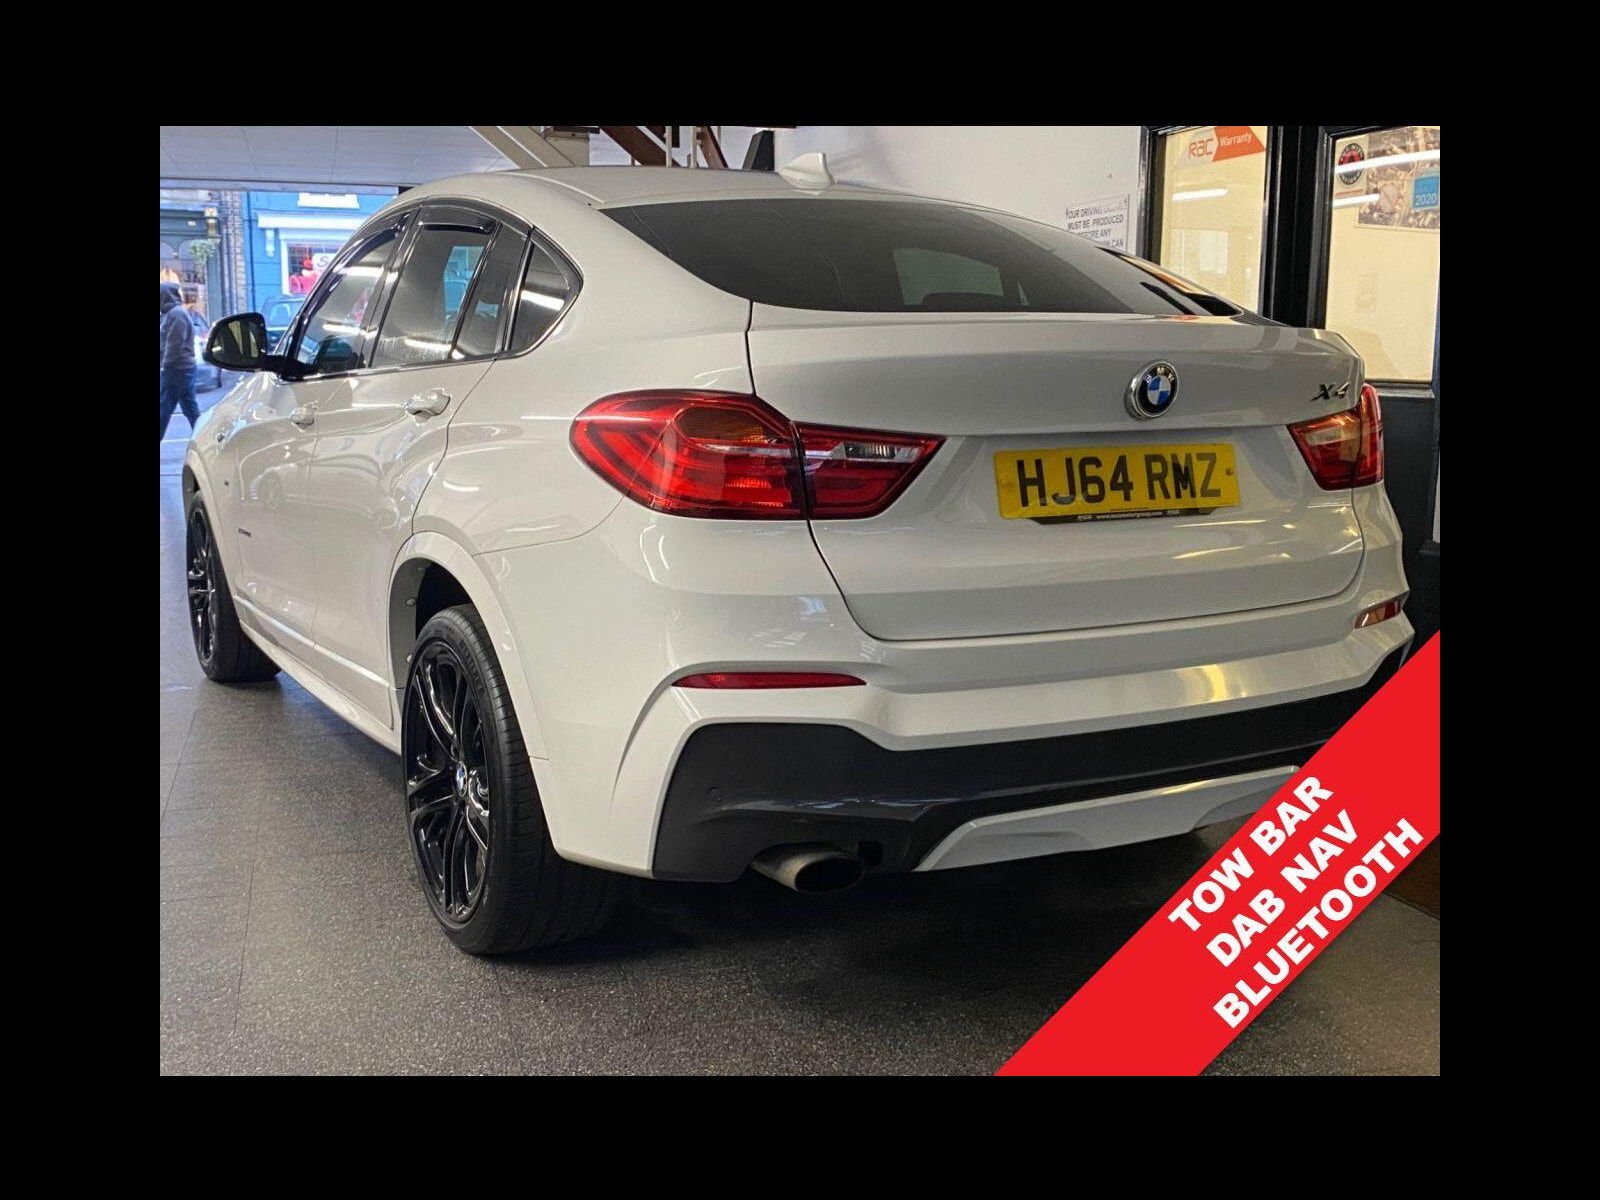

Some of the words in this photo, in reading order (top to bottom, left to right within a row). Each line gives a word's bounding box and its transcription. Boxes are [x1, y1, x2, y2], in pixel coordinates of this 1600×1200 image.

[1219, 131, 1252, 148] Warranty
[1080, 207, 1103, 217] DRIVING
[1067, 221, 1081, 230] MUST
[1082, 219, 1091, 229] BE
[1092, 214, 1124, 225] PRODUCED
[1100, 228, 1111, 237] ANY
[1111, 238, 1124, 248] CAN
[1310, 381, 1351, 401] X4
[1016, 455, 1134, 507] HJ64
[1144, 452, 1222, 501] RMZ
